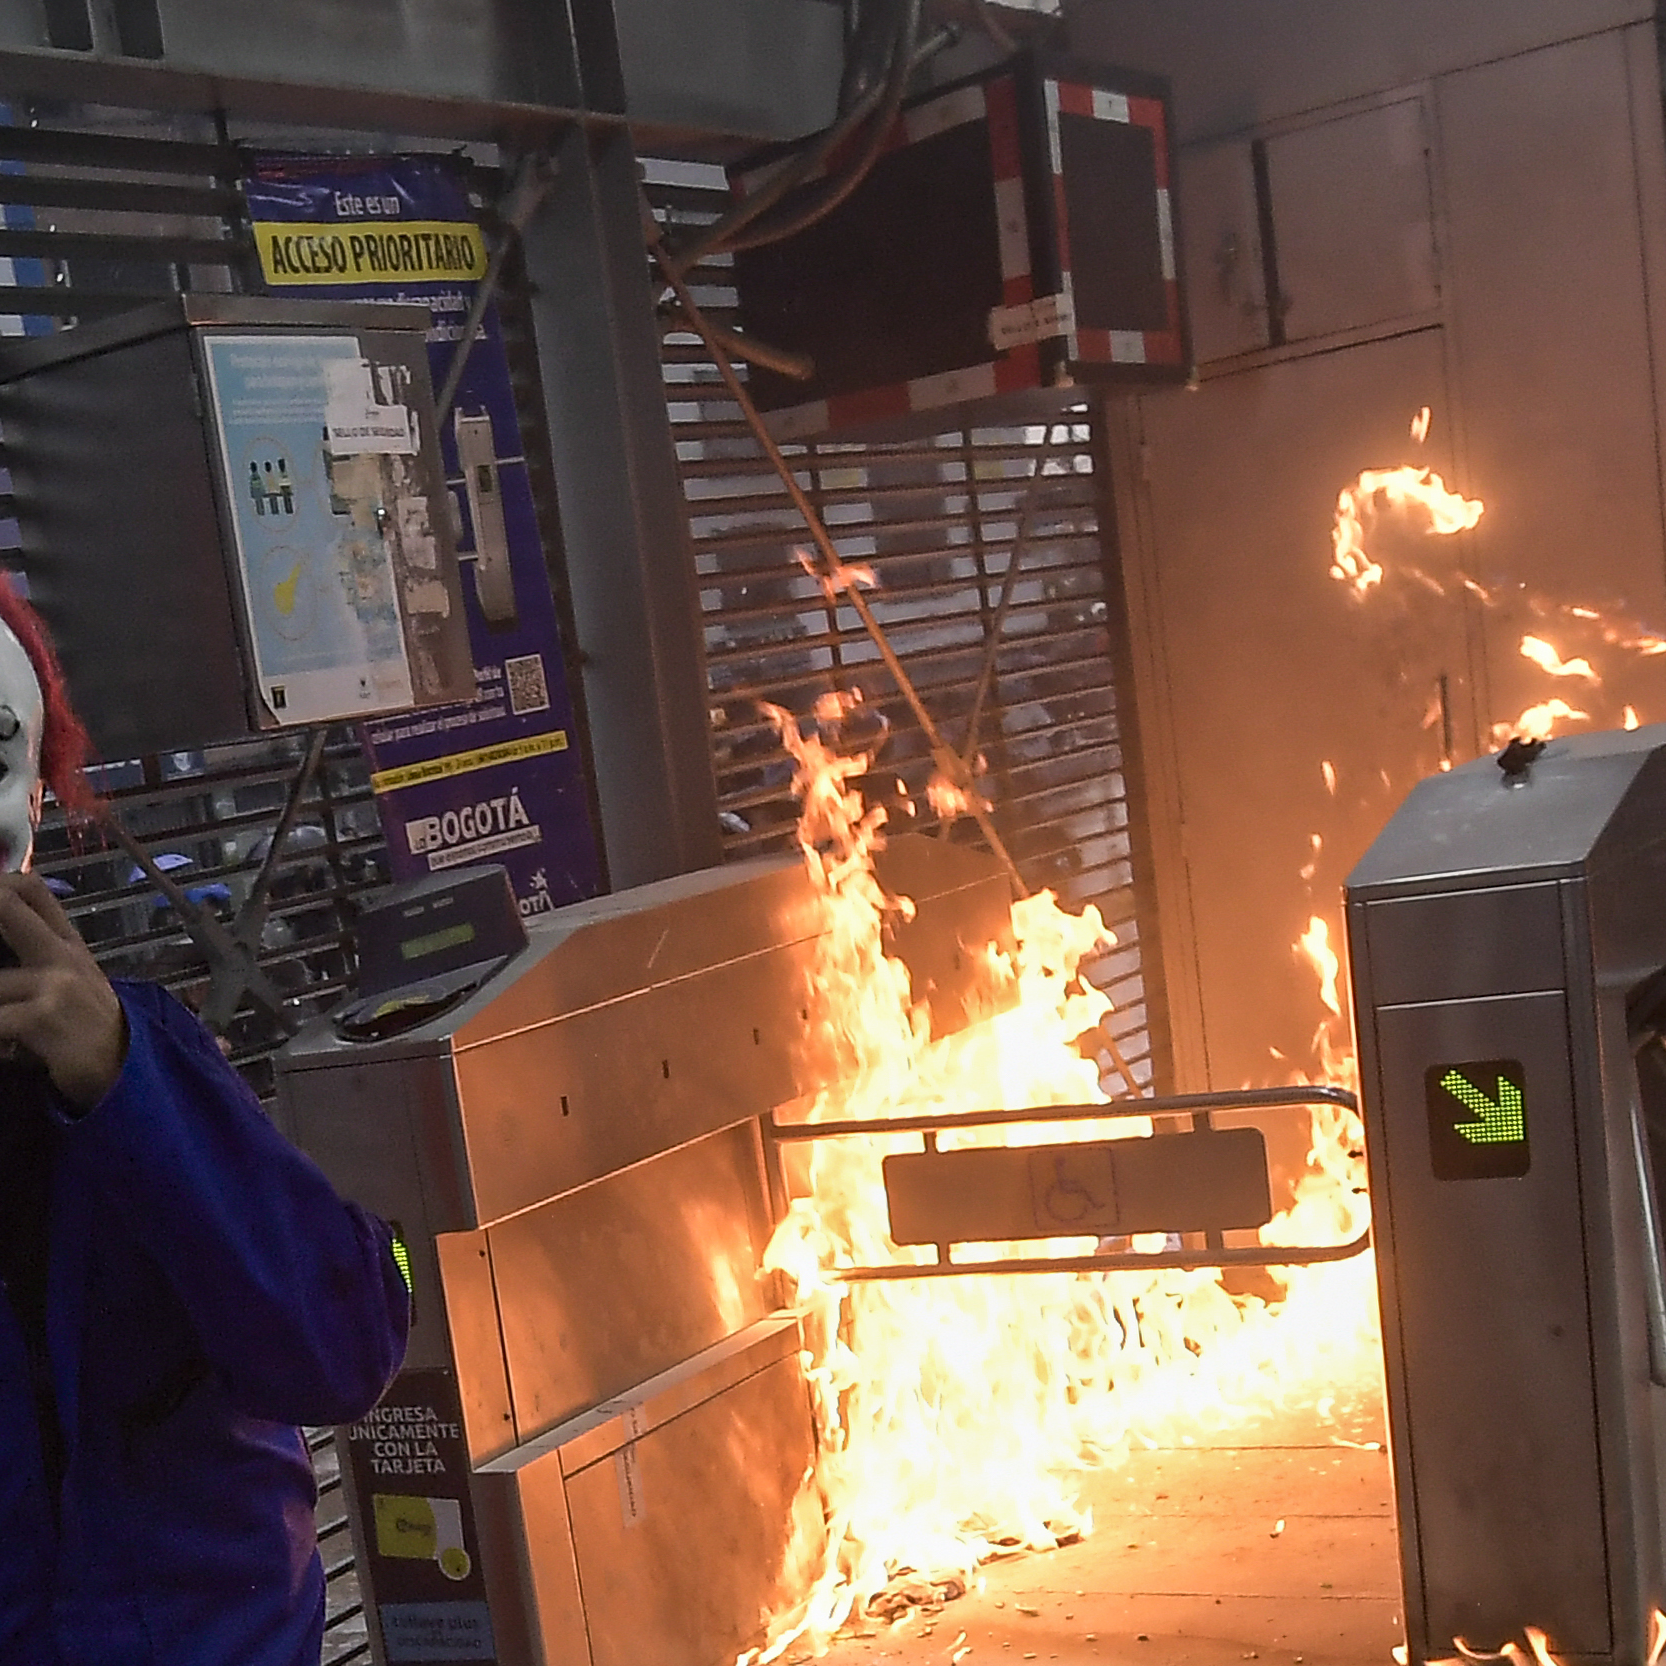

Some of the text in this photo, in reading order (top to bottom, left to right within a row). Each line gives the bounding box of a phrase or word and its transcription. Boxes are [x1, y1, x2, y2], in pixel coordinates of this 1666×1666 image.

[335, 191, 365, 216] Este
[366, 198, 381, 215] es
[271, 233, 475, 274] ACCESO PRIORITARIO
[426, 786, 530, 849] BOGOTÁ
[374, 1441, 438, 1458] CON LA
[371, 1458, 446, 1474] TARJETA
